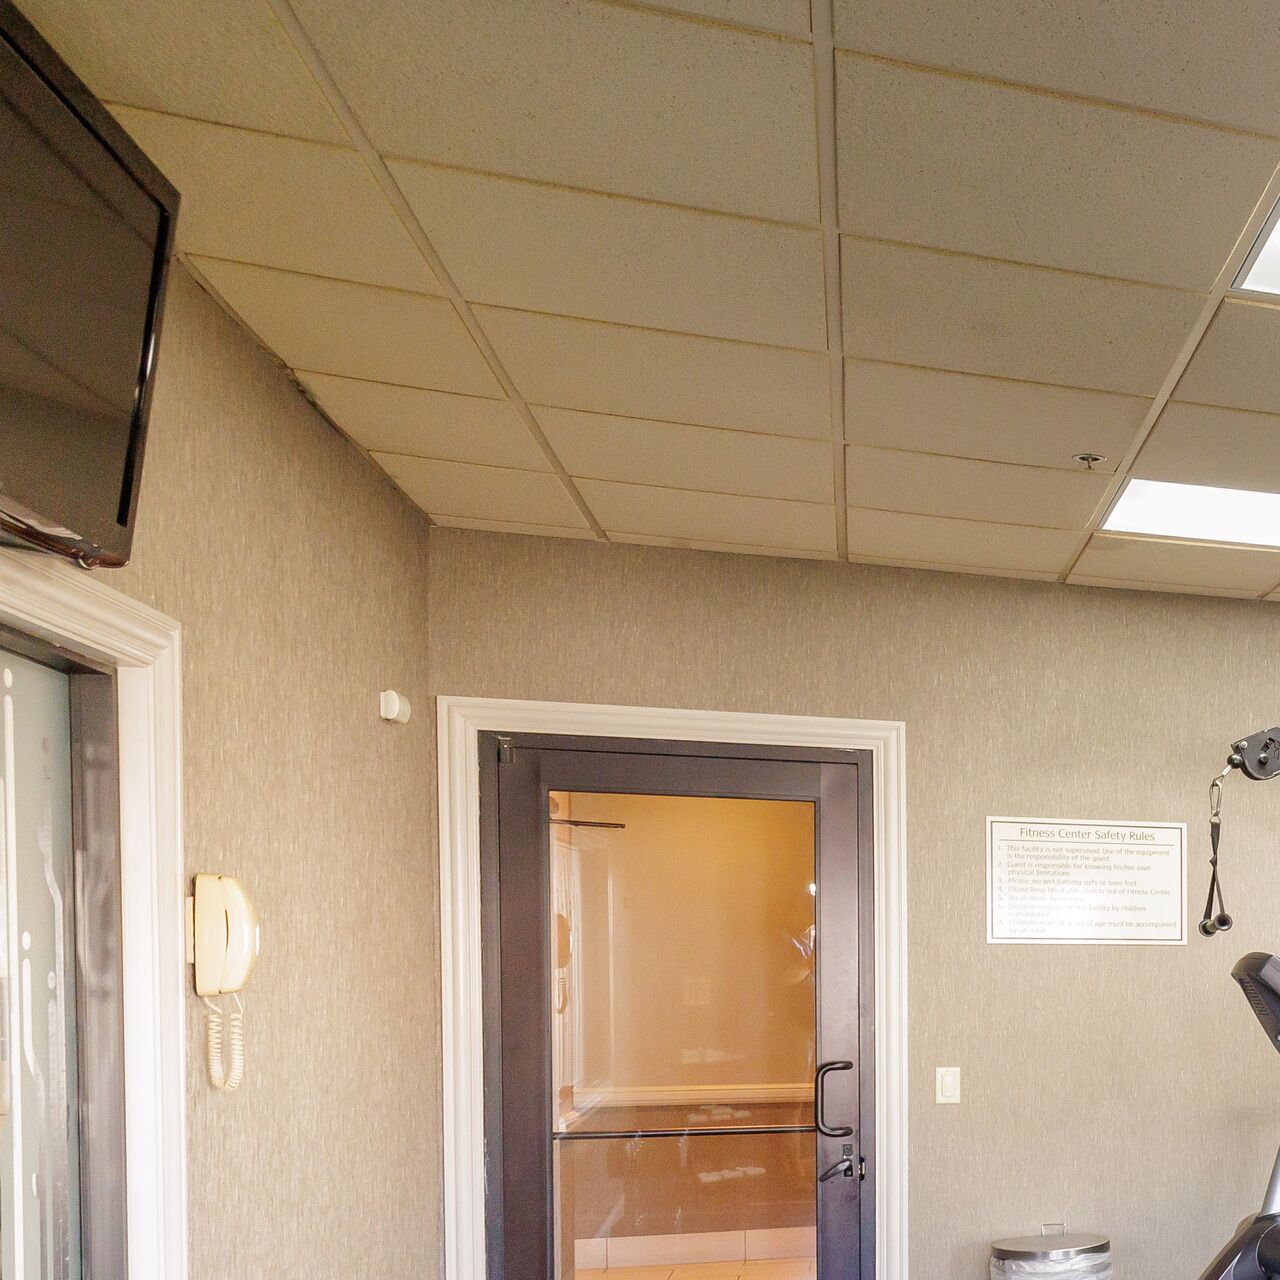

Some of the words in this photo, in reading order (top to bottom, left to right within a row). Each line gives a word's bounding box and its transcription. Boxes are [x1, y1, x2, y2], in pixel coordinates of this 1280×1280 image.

[1020, 827, 1055, 838] Fitness
[1058, 829, 1091, 839] Center
[1095, 830, 1126, 842] Safety
[1129, 831, 1155, 841] Rules
[1022, 845, 1043, 853] facility
[1026, 854, 1070, 862] responsibility
